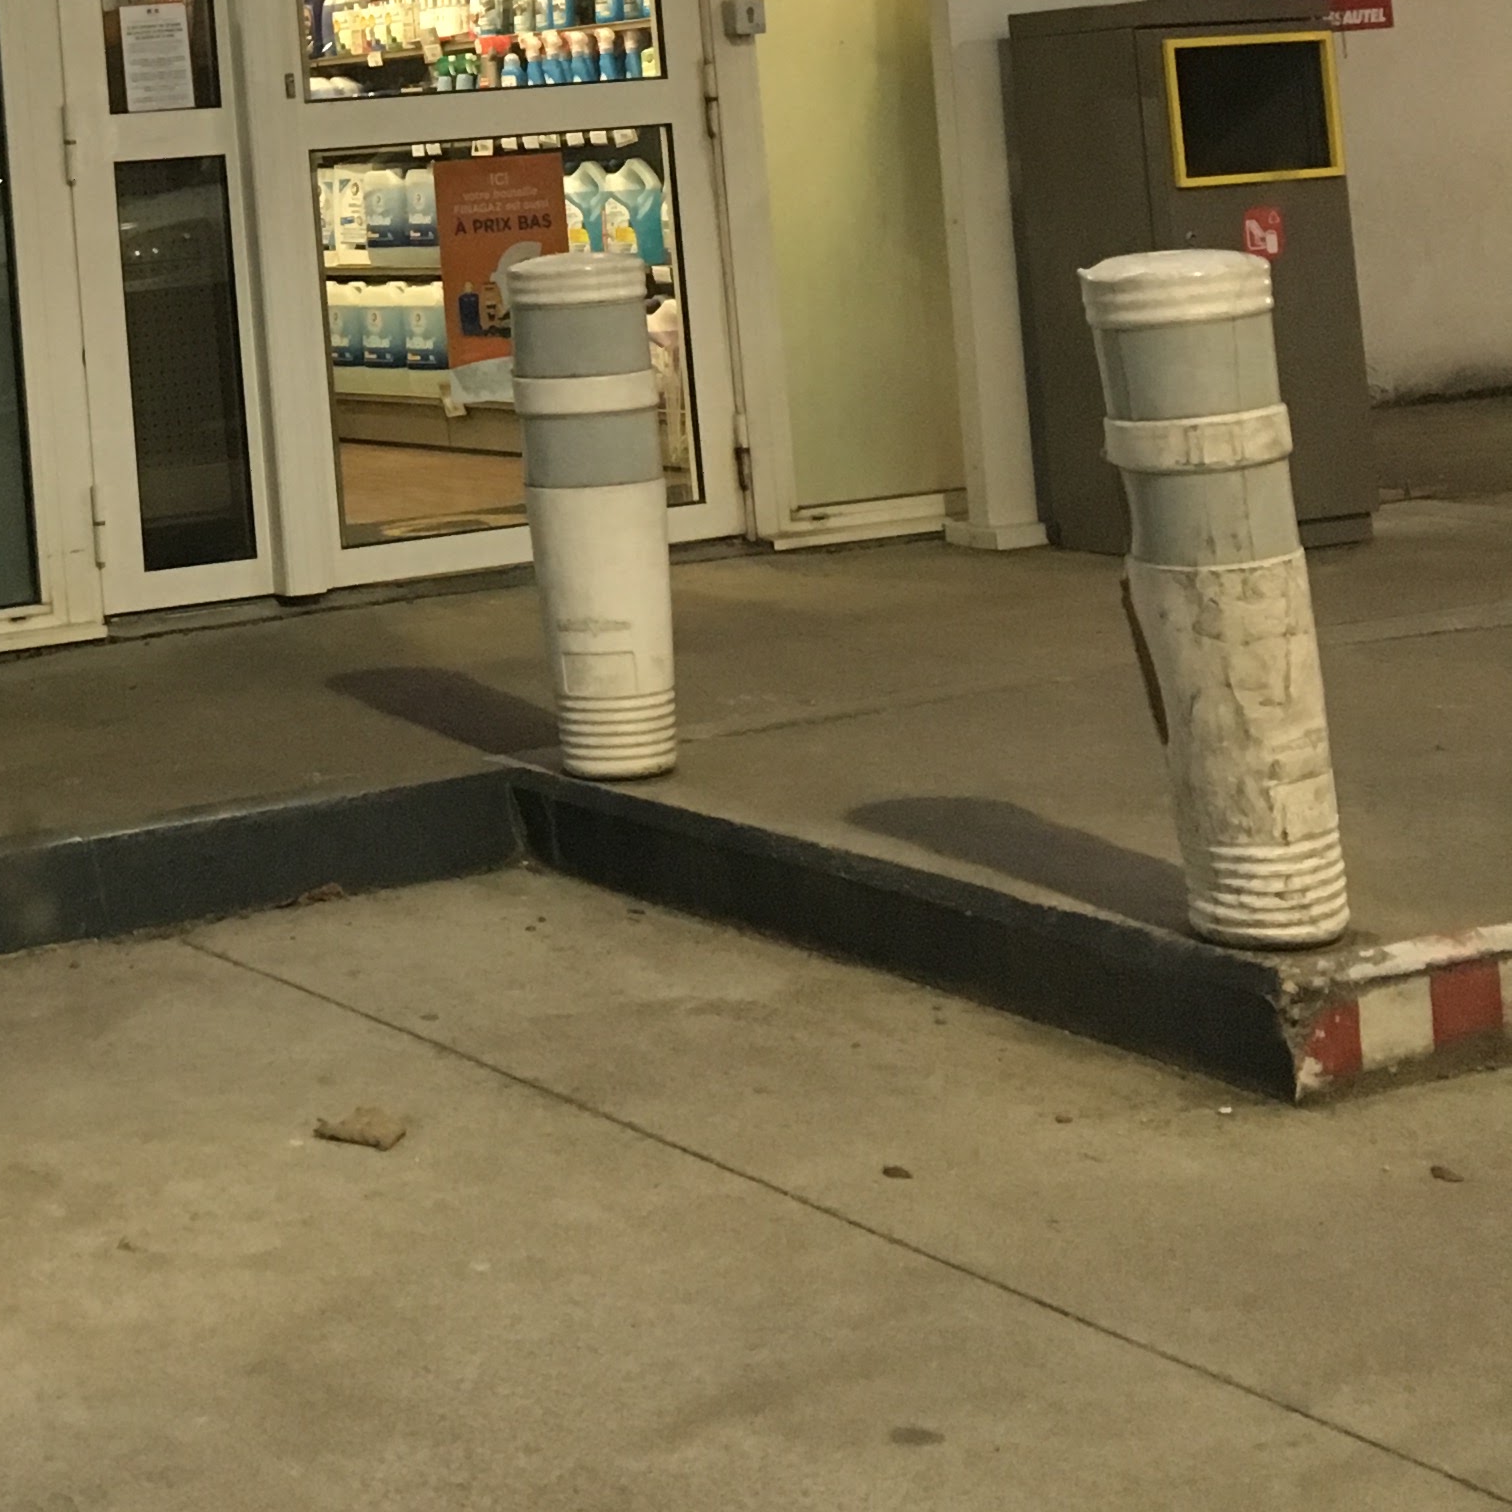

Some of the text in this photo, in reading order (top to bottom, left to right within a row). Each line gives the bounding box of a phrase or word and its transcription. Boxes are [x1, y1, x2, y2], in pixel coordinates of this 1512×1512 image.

[490, 172, 509, 186] ICI
[472, 217, 512, 234] PRIX
[518, 213, 553, 231] BAS
